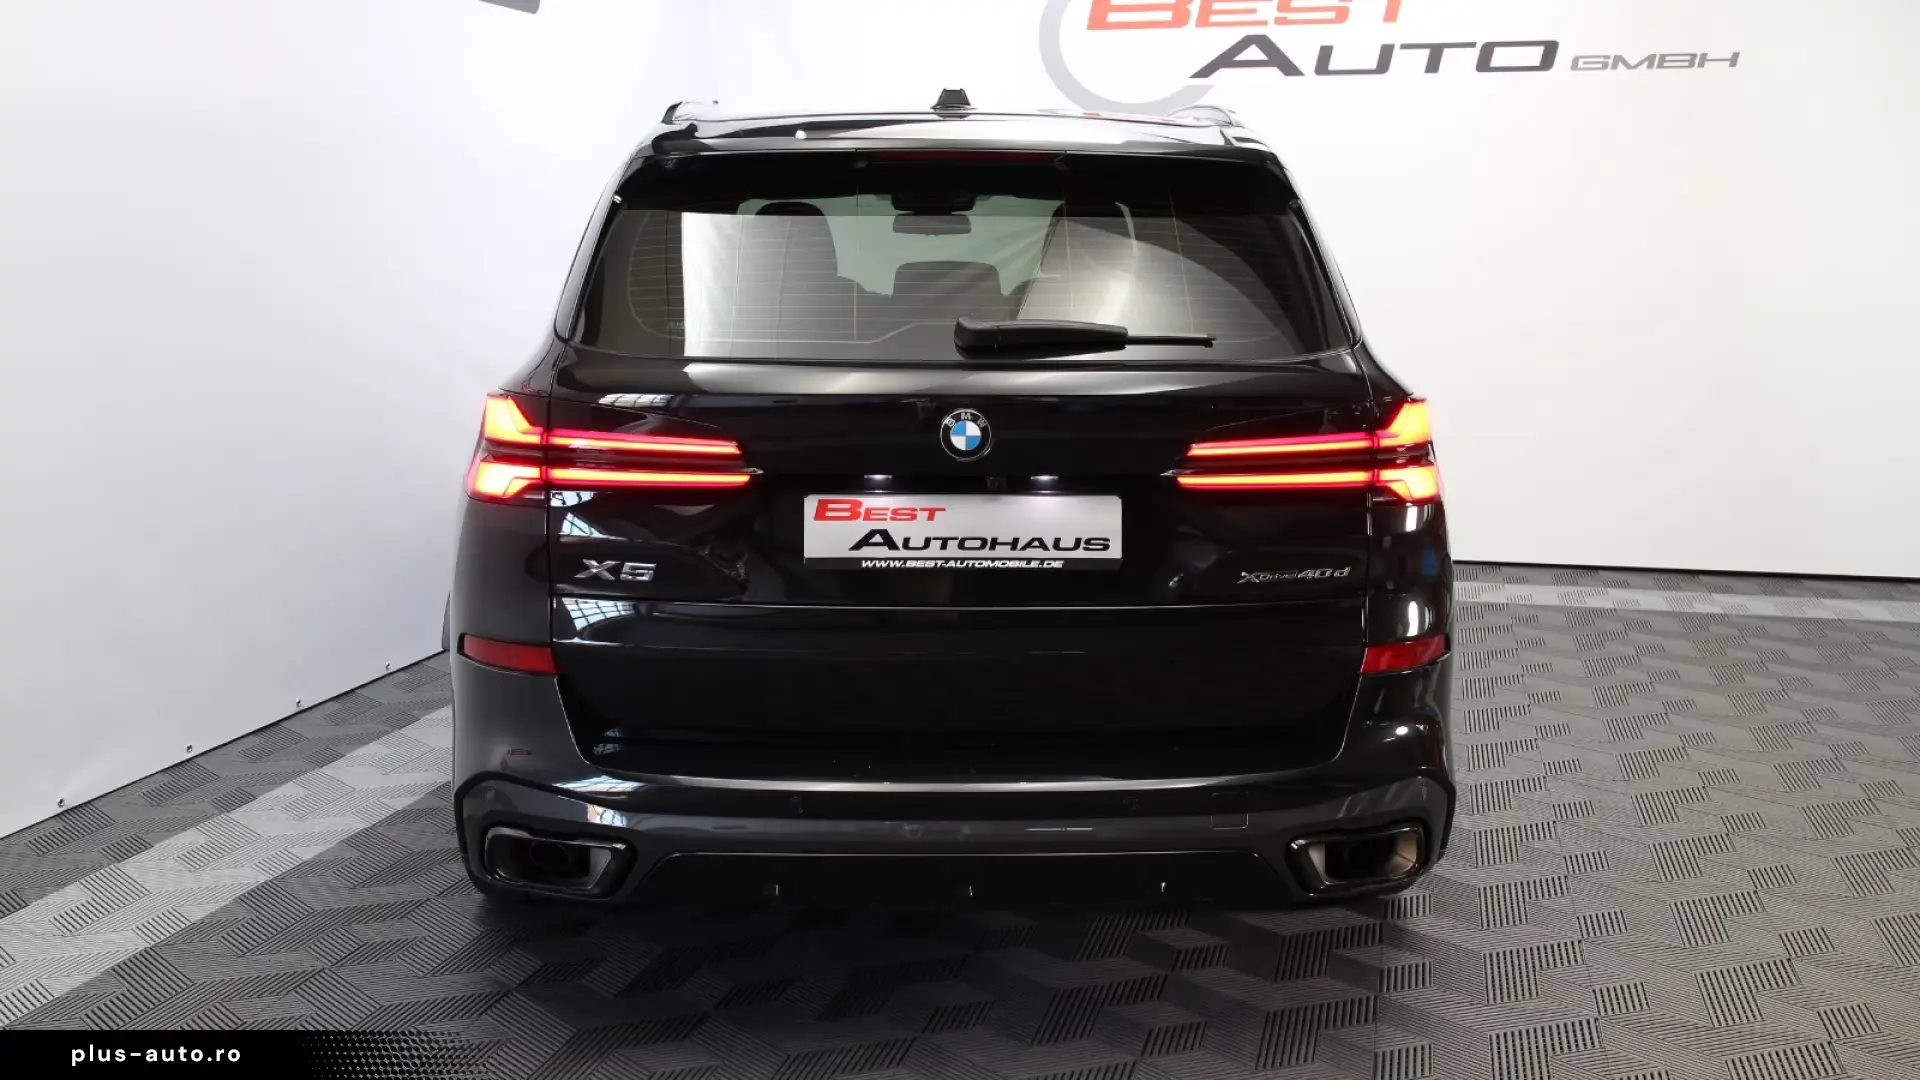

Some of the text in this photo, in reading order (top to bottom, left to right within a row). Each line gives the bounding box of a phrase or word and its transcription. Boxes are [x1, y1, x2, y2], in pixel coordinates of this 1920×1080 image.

[1188, 34, 1740, 79] AUTO GMBH
[944, 412, 988, 428] BMW
[813, 498, 946, 522] BEST
[848, 528, 1111, 552] AUTOHAUS
[574, 559, 657, 581] X5
[861, 559, 1064, 569] WWW.BEST-AUTOMOBILE.DE
